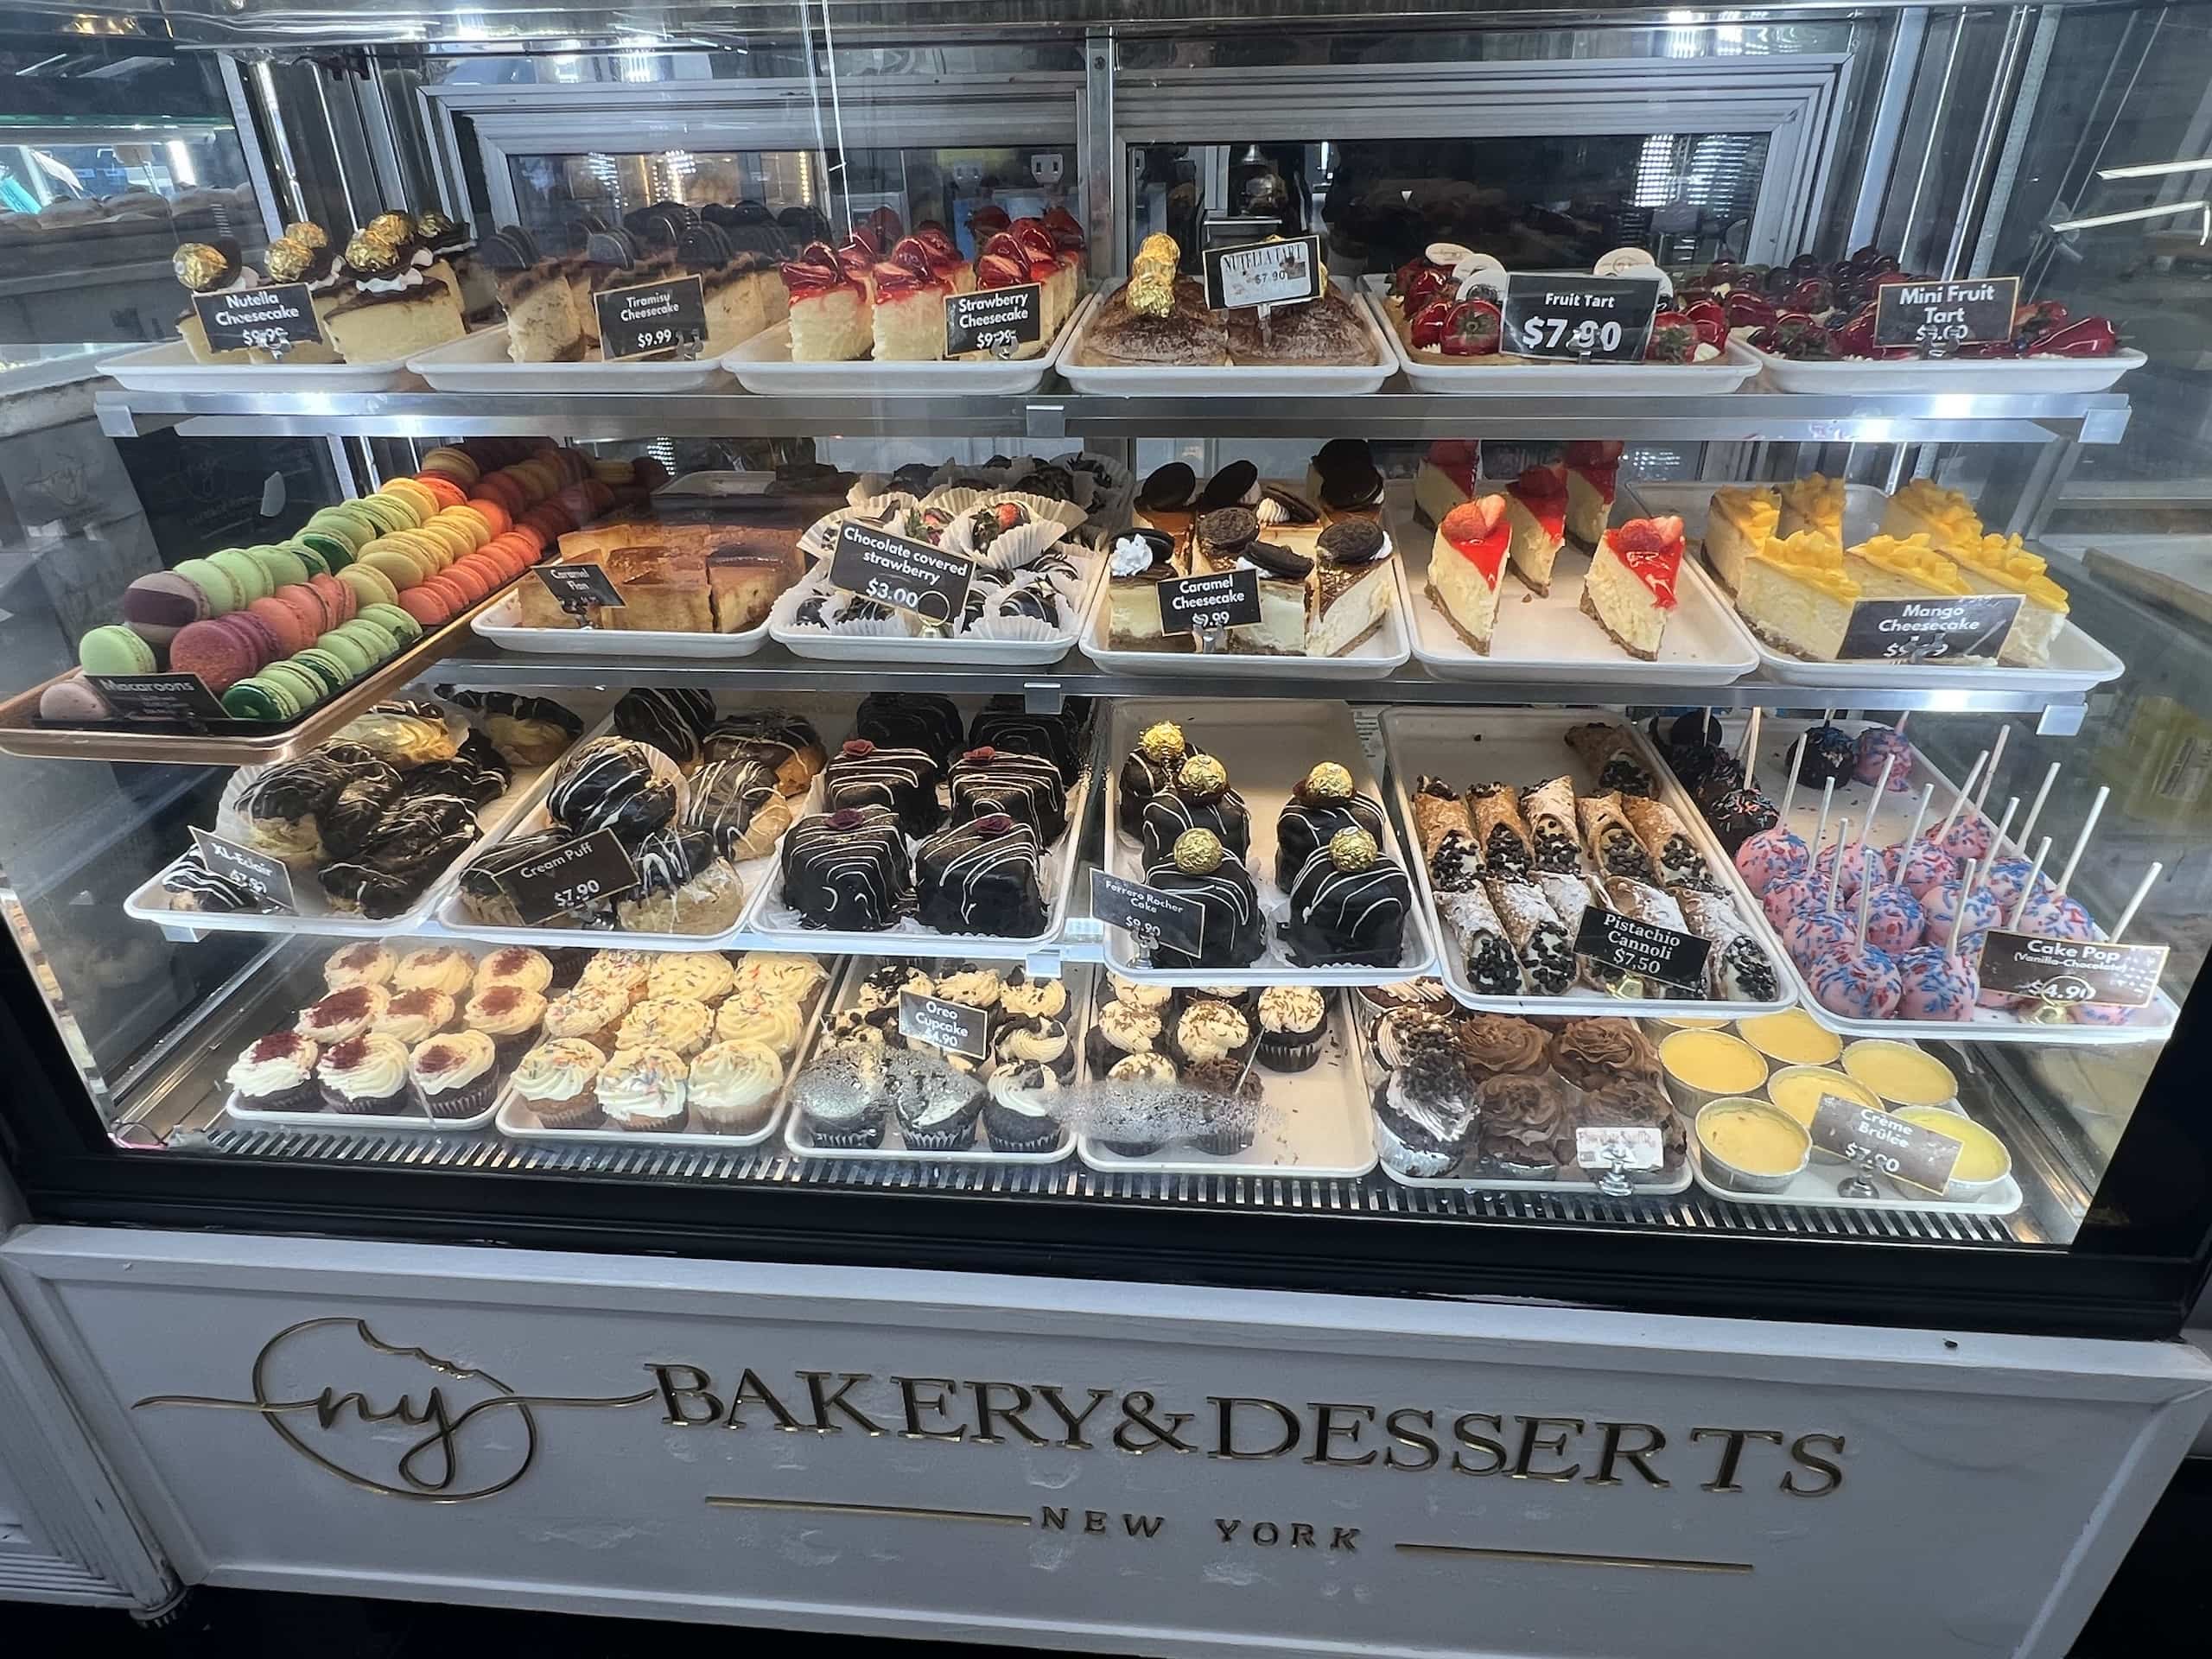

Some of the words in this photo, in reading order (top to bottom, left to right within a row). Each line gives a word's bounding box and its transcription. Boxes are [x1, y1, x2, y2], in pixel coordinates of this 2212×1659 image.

[226, 290, 280, 308] Nutella
[626, 292, 671, 308] Tiramisu
[958, 293, 1028, 313] Strawberry
[1545, 292, 1580, 307] Fruit
[1584, 295, 1616, 308] Tart
[1899, 287, 1943, 305] Mini
[1947, 283, 1996, 302] Fruit
[215, 305, 300, 326] Cheesecake
[620, 302, 680, 321] Cheesecake
[959, 307, 1029, 328] Cheesecake
[1923, 307, 1966, 324] Tart
[637, 329, 672, 348] $9.99
[843, 527, 912, 558] Chocolate
[912, 551, 969, 577] covered
[862, 551, 941, 586] strawberry
[866, 577, 918, 607] $3.00
[1179, 574, 1234, 594] Caramel
[1172, 589, 1245, 610] Cheesecake
[1902, 604, 1965, 620] Mango
[1878, 618, 1980, 632] Cheesecake
[520, 855, 566, 879] Cream
[564, 842, 594, 861] Puff
[554, 880, 601, 907] $7.90
[1105, 880, 1145, 900] Ferrero
[1146, 893, 1184, 913] Rocher
[1130, 898, 1158, 913] Cake
[1603, 913, 1681, 947] Pistachio
[1607, 930, 1673, 960] Cannoli
[2027, 939, 2078, 958] Cake
[2082, 945, 2120, 963] Pop
[925, 1001, 958, 1020] Oreo
[915, 1012, 969, 1037] Cupcake
[1040, 1505, 1165, 1539] NEW
[1214, 1518, 1362, 1551] YORK
